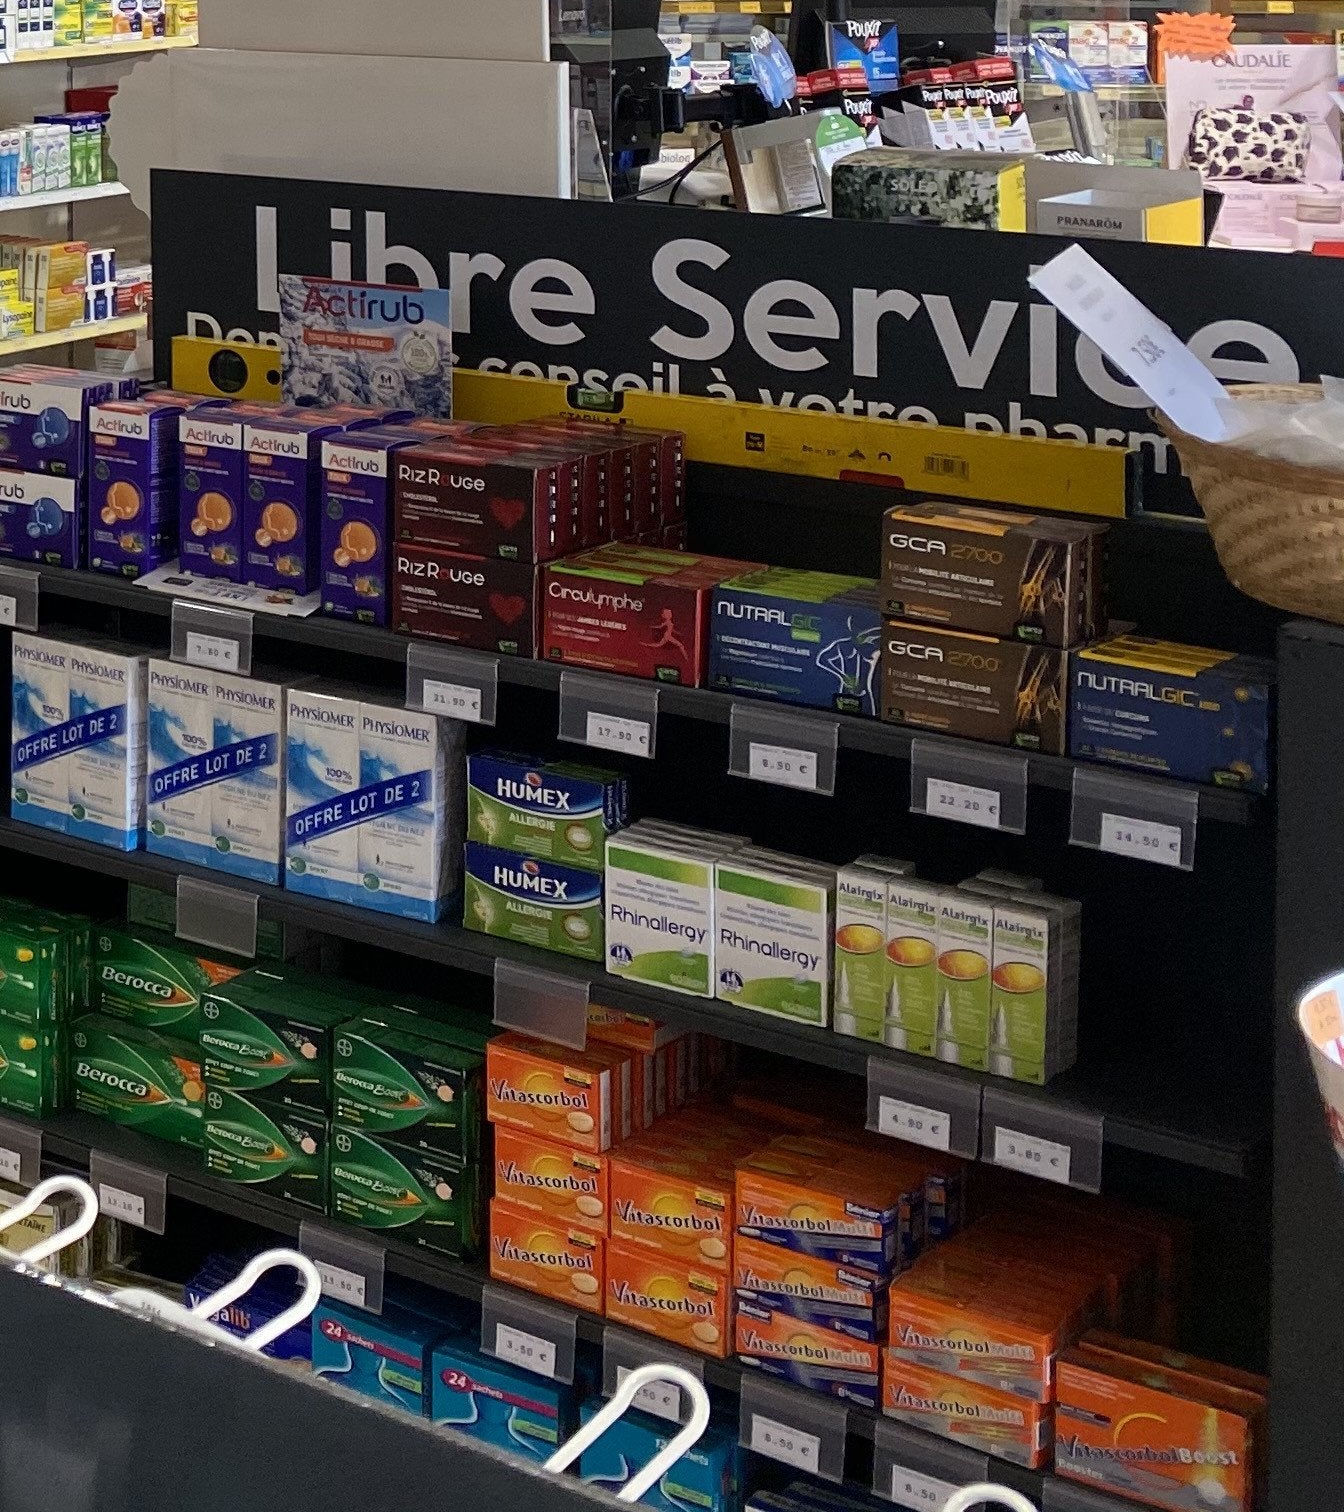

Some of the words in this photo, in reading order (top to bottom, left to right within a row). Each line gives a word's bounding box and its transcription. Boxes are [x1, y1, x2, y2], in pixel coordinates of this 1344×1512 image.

[303, 287, 424, 326] Actirub
[95, 413, 143, 436] Actirub
[185, 425, 235, 447] Actirub
[249, 434, 300, 456] Actirub
[329, 451, 379, 474] Actirub
[889, 532, 947, 557] GCA
[950, 544, 1003, 565] 2700
[549, 582, 643, 612] Circulymphe
[888, 640, 944, 663] GCA
[948, 652, 998, 673] 2700
[41, 705, 64, 718] 100%
[17, 733, 58, 762] OFFRE
[62, 723, 85, 746] LOT
[88, 719, 105, 737] DE
[109, 715, 118, 731] 2
[182, 733, 207, 749] 100%
[639, 734, 646, 744] €
[154, 766, 200, 793] OFFRE
[205, 753, 232, 776] LOT
[235, 749, 254, 767] DE
[258, 743, 268, 761] 2
[295, 805, 344, 837] OFFRE
[349, 793, 379, 817] LOT
[384, 785, 406, 804] DE
[411, 780, 421, 798] 2
[496, 776, 571, 811] HUMEX
[508, 811, 556, 833] ALLERGIE
[989, 805, 997, 815] €
[493, 865, 569, 899] HUMEX
[838, 882, 884, 902] Alairgix
[505, 901, 553, 920] ALLERGIE
[889, 893, 936, 914] Alairgix
[940, 905, 989, 927] Alairgix
[610, 903, 708, 944] Rhinallergy
[995, 918, 1045, 940] Alairgix
[720, 928, 821, 972] Rhinallergy
[101, 966, 173, 999] Berocca
[76, 1060, 147, 1096] Berocca
[491, 1078, 588, 1108] Vitascorbol
[499, 1161, 597, 1192] Vitascorbol
[615, 1199, 721, 1231] Vitascorbol
[494, 1236, 592, 1268] Vitascorbol
[611, 1280, 714, 1316] Vitascorbol
[326, 1322, 343, 1338] 24
[449, 1372, 467, 1387] 24
